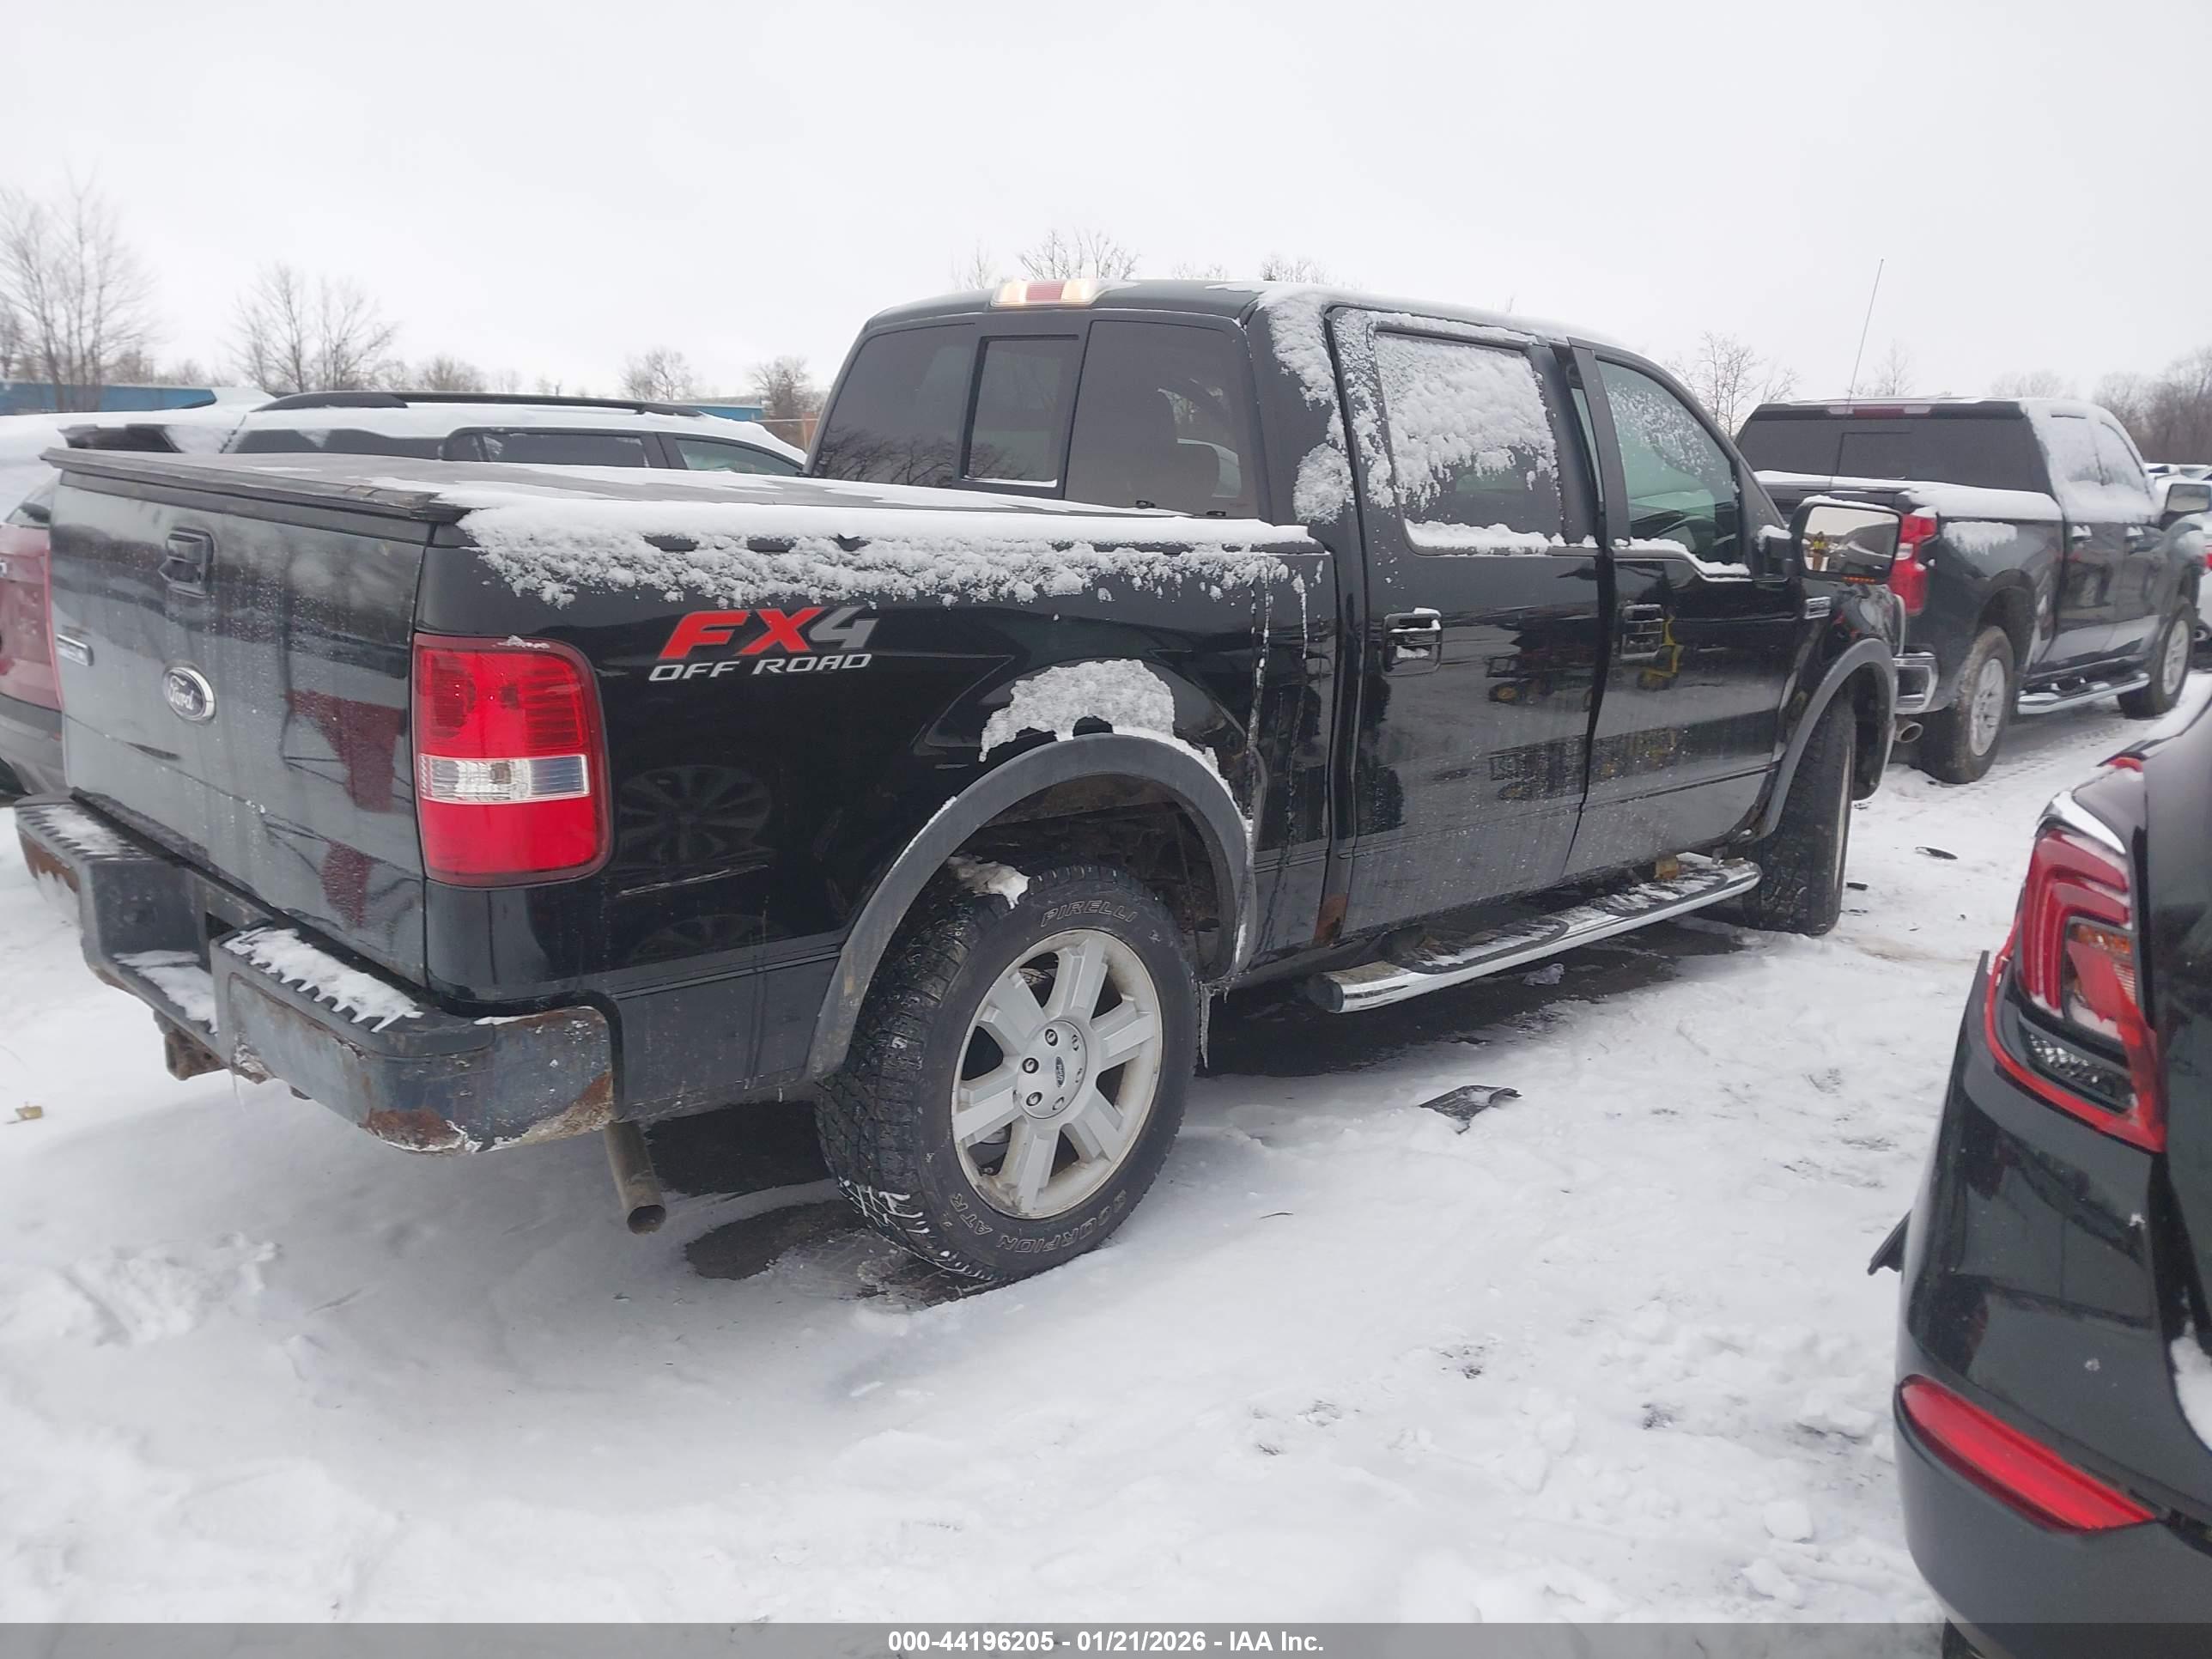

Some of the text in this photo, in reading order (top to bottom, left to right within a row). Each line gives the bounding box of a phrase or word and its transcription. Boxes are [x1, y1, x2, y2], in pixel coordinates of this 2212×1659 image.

[658, 606, 879, 660] FX4
[648, 653, 872, 681] OFF ROAD
[1040, 899, 1139, 928] PIRELLI
[995, 1188, 1127, 1254] SCORPION
